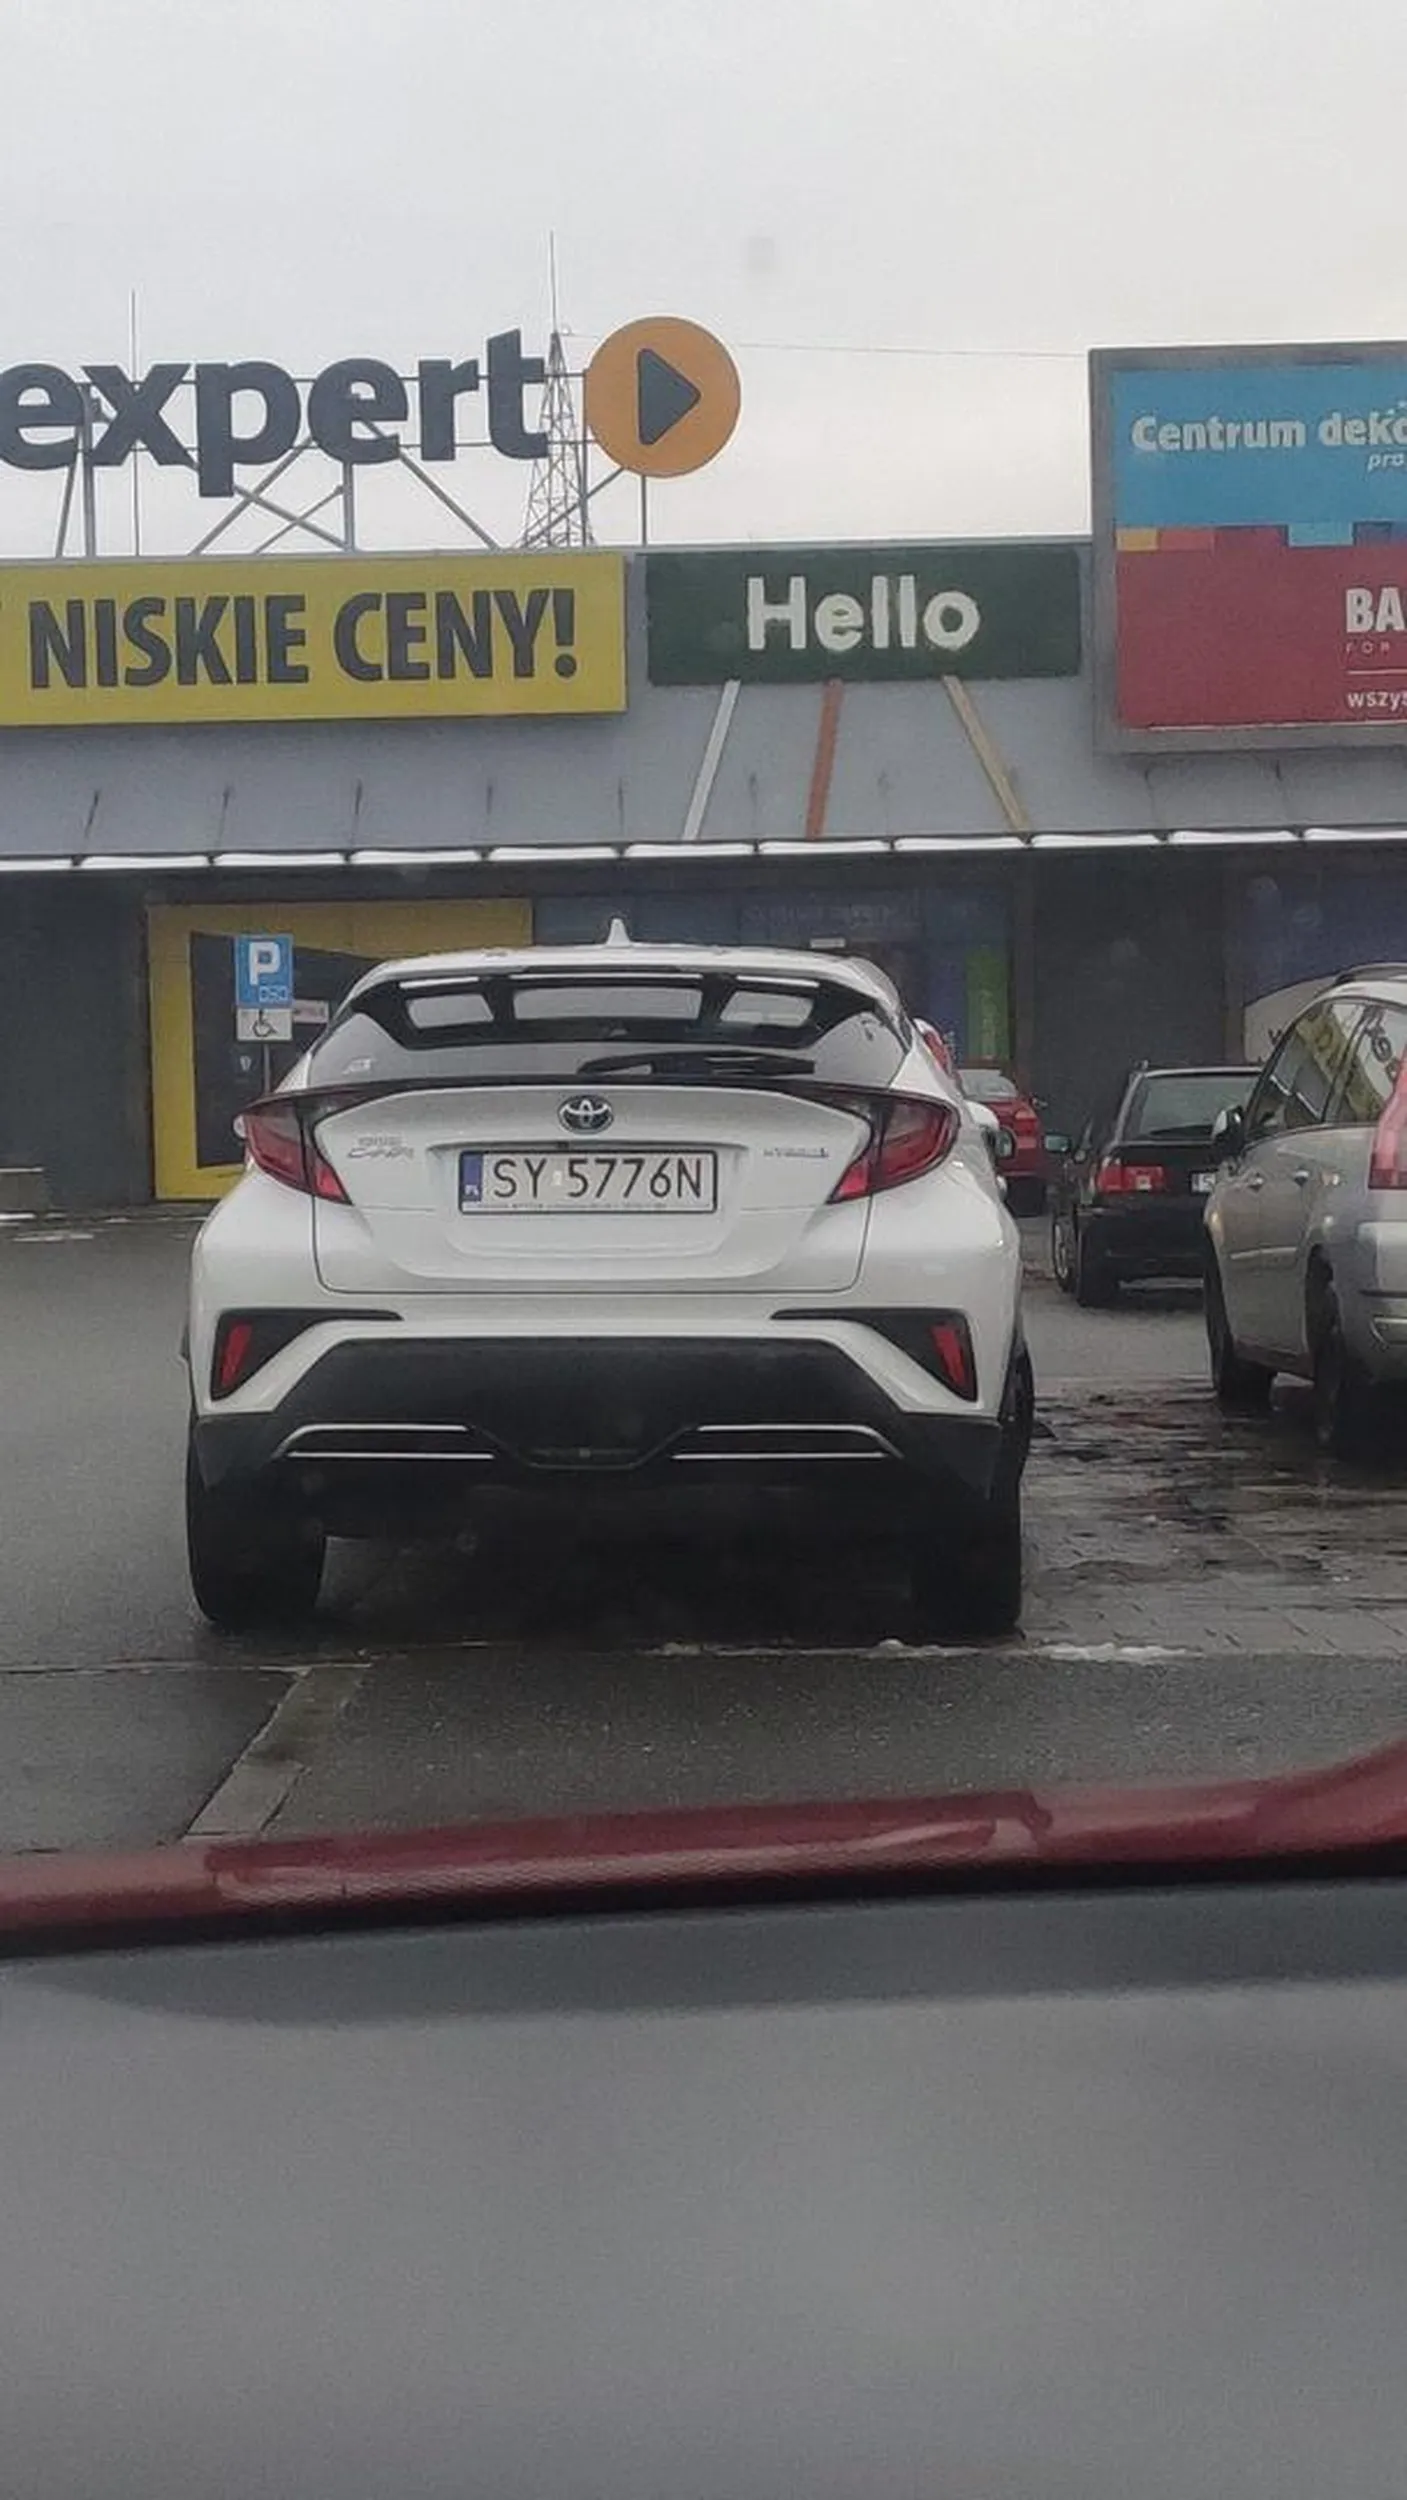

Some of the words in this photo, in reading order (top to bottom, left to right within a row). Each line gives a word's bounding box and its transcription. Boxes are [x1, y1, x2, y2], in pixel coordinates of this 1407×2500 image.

[0, 329, 549, 497] expert
[1131, 415, 1306, 451] Centrum
[29, 594, 309, 688] NISKIE
[333, 588, 577, 681] CENY!
[747, 575, 980, 651] Hello
[249, 942, 280, 986] P
[493, 1158, 547, 1199] SY
[567, 1158, 701, 1199] 5776N
